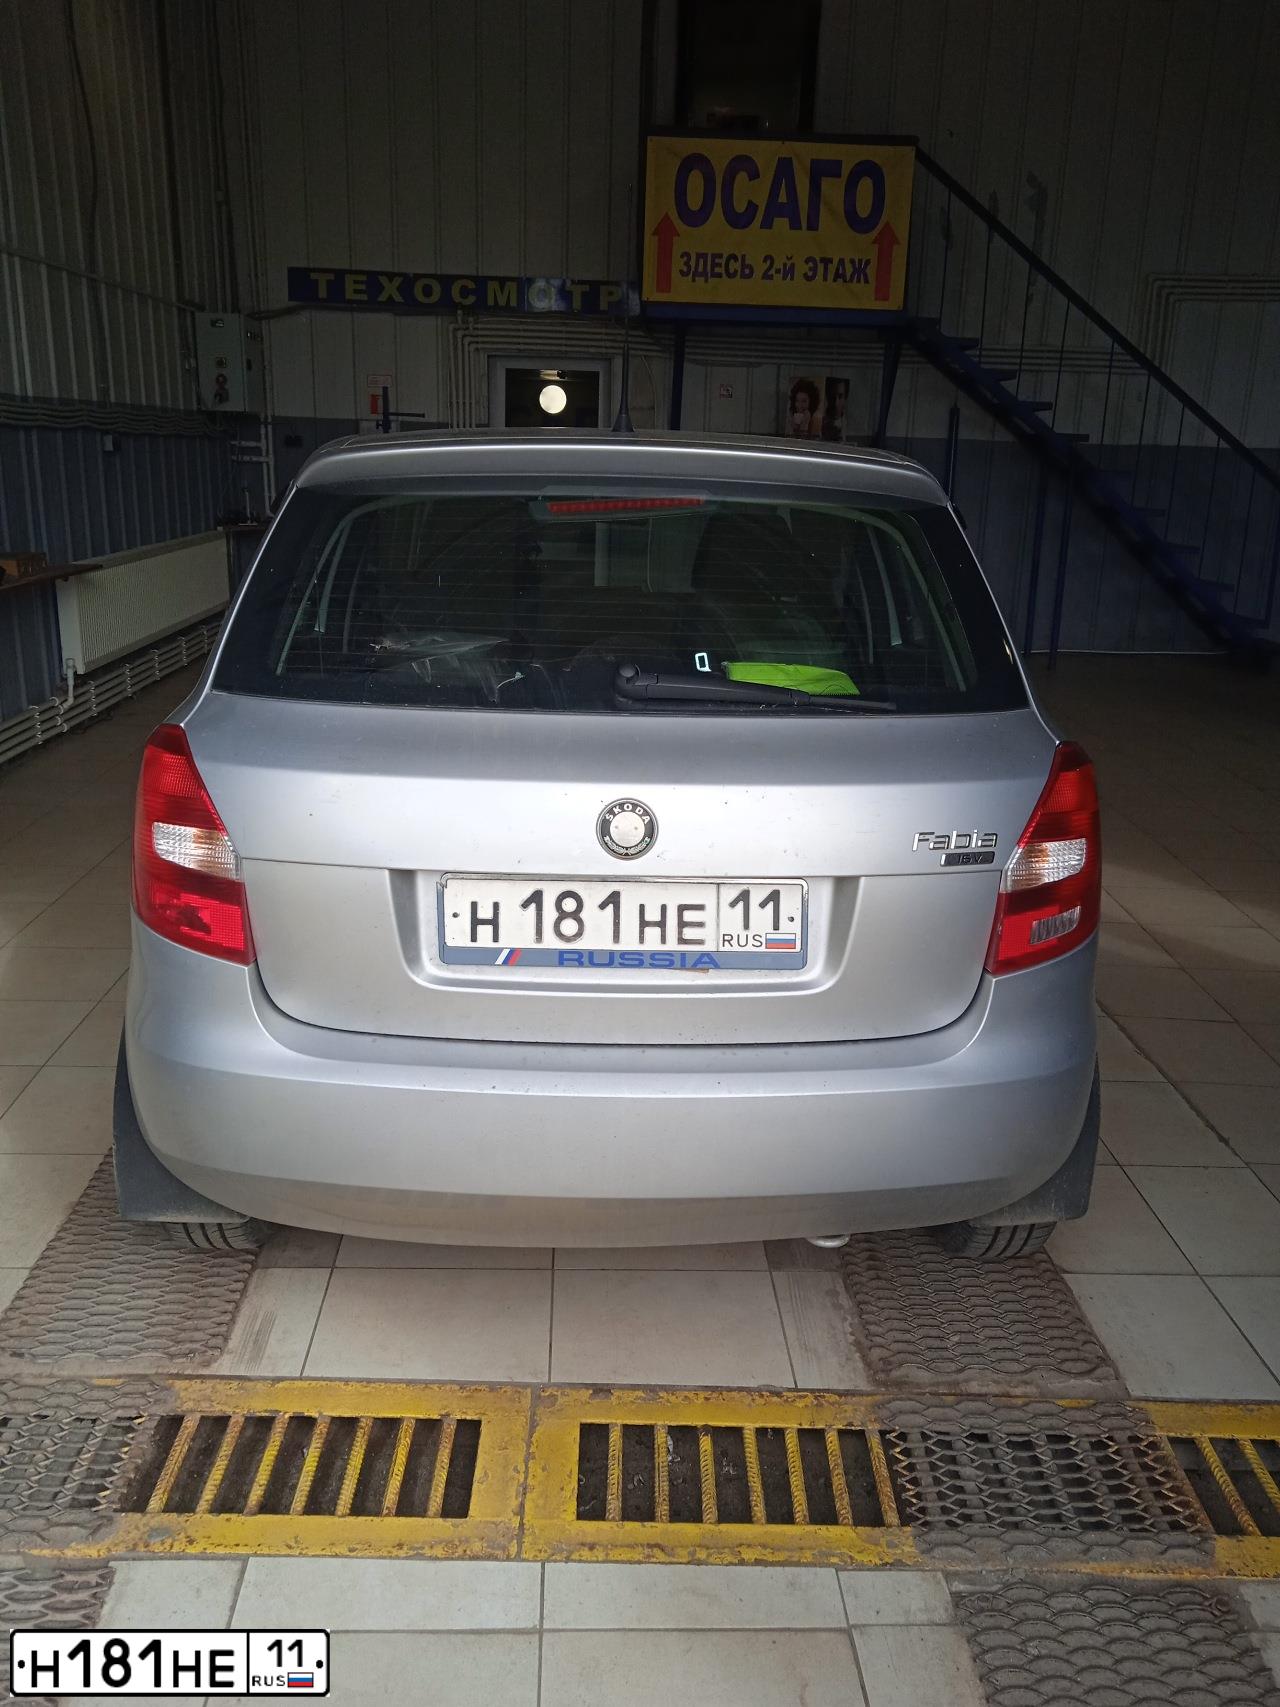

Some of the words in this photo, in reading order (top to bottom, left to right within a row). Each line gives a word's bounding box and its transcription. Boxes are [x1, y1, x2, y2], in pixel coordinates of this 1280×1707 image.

[674, 152, 886, 234] ОСАГО
[679, 251, 755, 283] ЗДЕСЬ
[761, 254, 796, 281] 2-й
[803, 256, 872, 284] ЭТАЖ
[308, 271, 625, 312] ТЕХОСМОТР
[912, 829, 998, 852] Fabia
[729, 889, 781, 931] 11
[722, 933, 764, 948] RUS
[558, 950, 721, 969] RUSSIA
